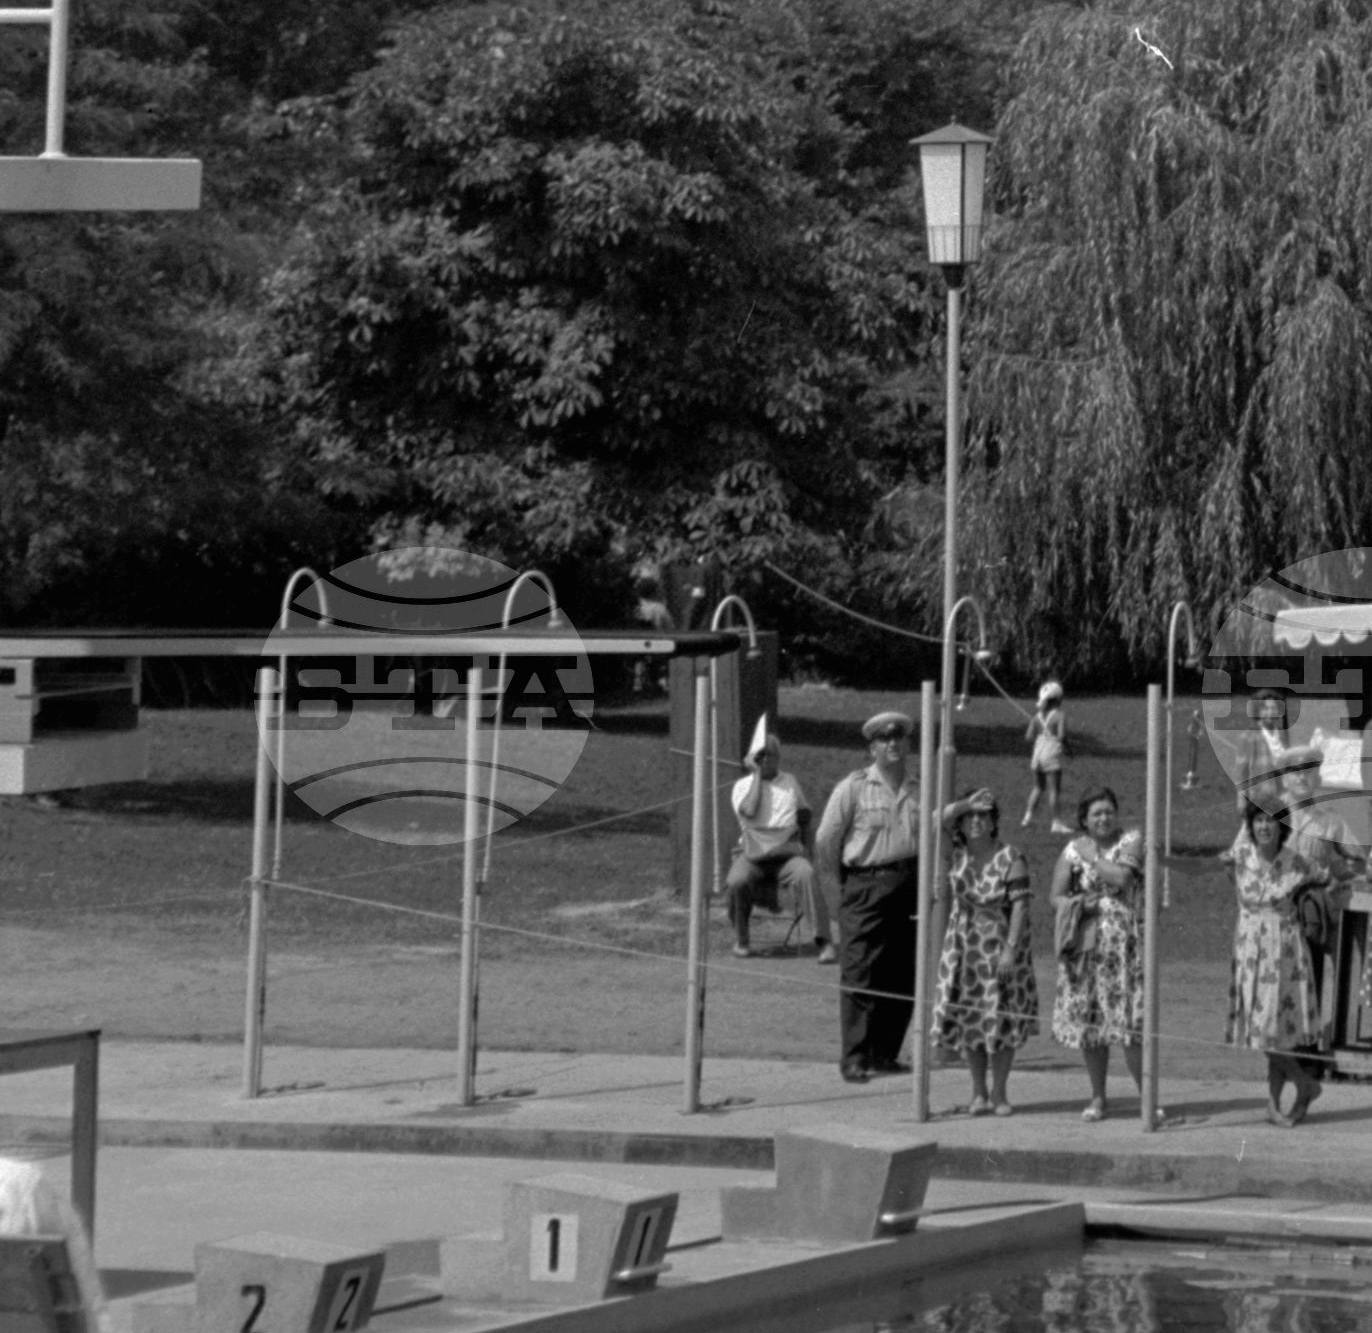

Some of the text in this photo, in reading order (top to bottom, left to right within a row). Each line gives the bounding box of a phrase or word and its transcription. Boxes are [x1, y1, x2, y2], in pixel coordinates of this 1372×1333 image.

[547, 1218, 561, 1273] 1
[241, 1284, 267, 1333] 2
[333, 1276, 362, 1332] 2
